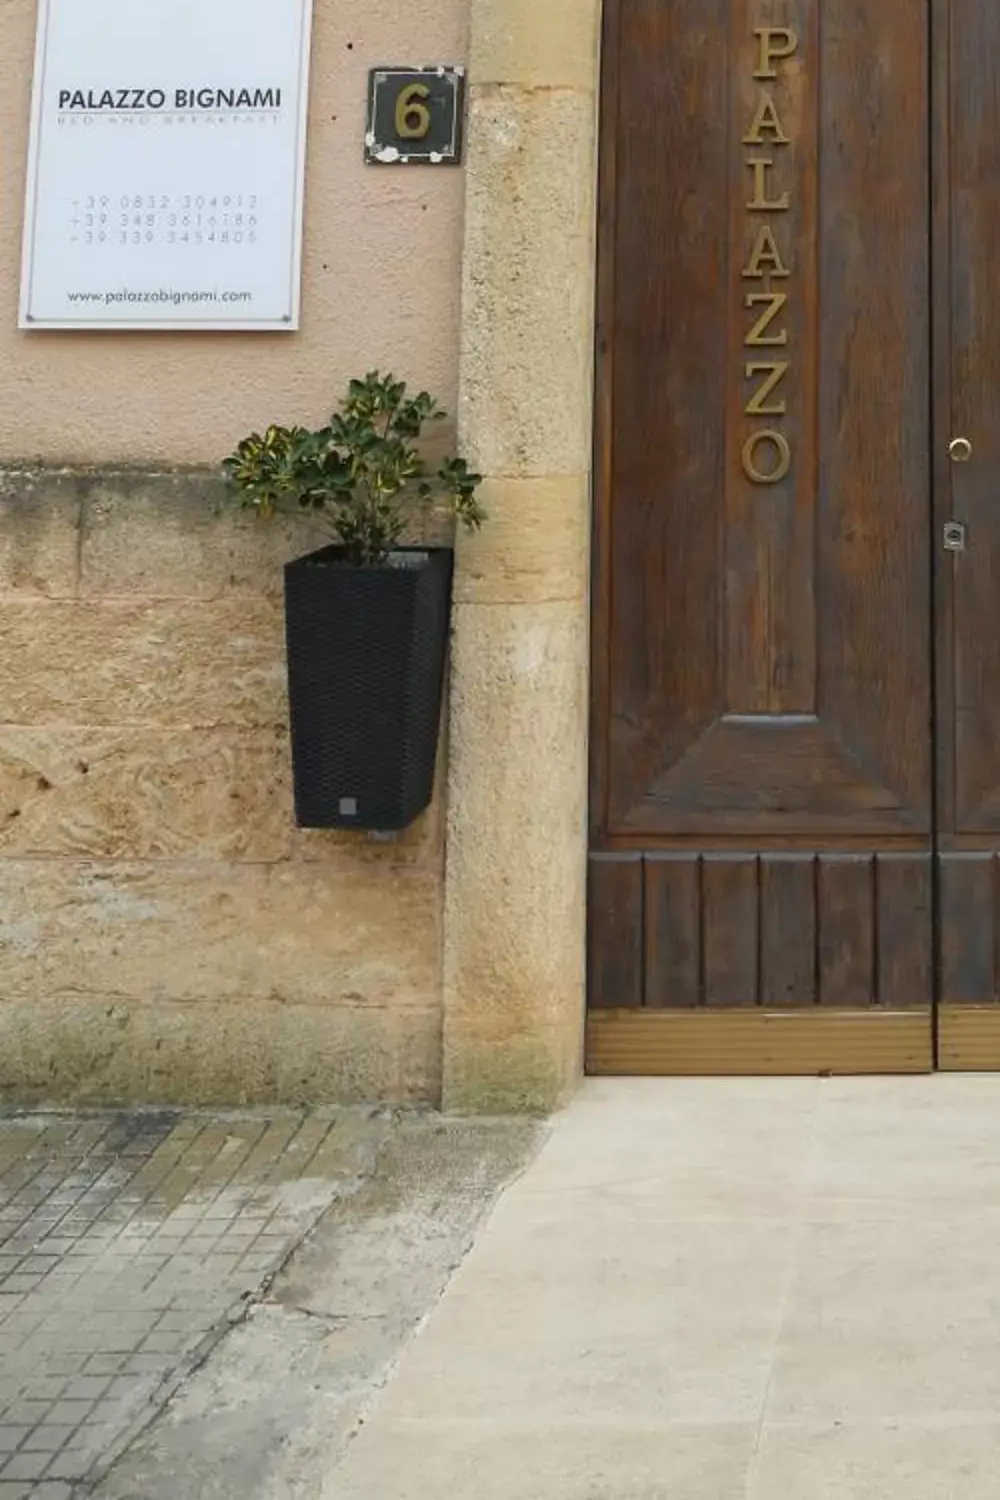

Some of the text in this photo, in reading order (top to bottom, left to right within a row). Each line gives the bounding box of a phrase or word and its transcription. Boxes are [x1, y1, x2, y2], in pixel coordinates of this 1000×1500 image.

[59, 88, 281, 109] PALAZZO BIGNAMI
[395, 83, 431, 138] 6
[741, 26, 798, 484] PALAZZO
[67, 288, 252, 305] www.palazzobignami.com
